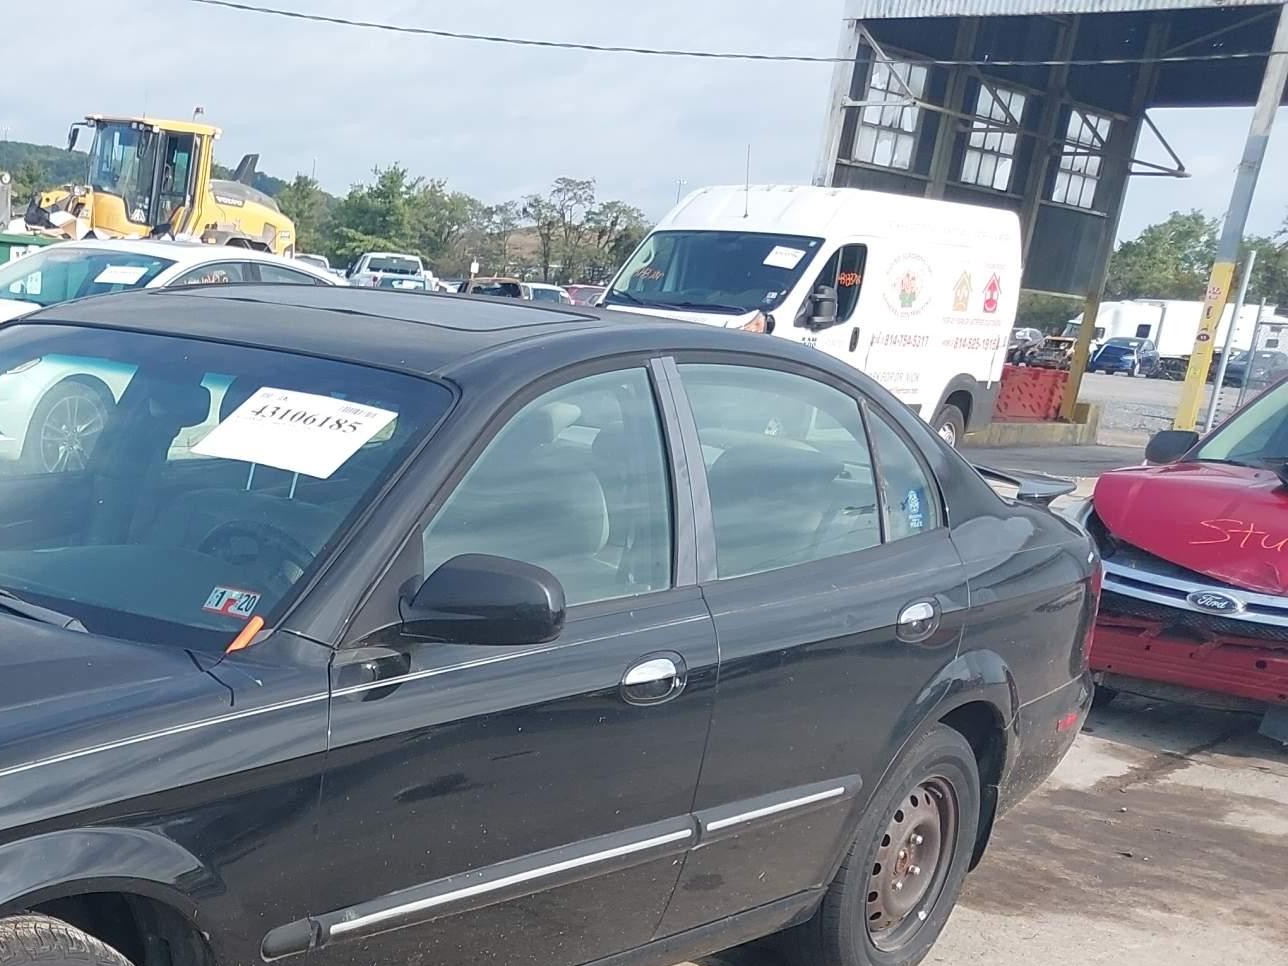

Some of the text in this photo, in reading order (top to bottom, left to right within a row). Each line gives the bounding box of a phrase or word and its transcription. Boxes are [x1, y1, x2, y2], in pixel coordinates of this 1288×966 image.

[251, 404, 364, 434] 43106185
[237, 593, 257, 612] 20
[1197, 594, 1227, 609] Ford
